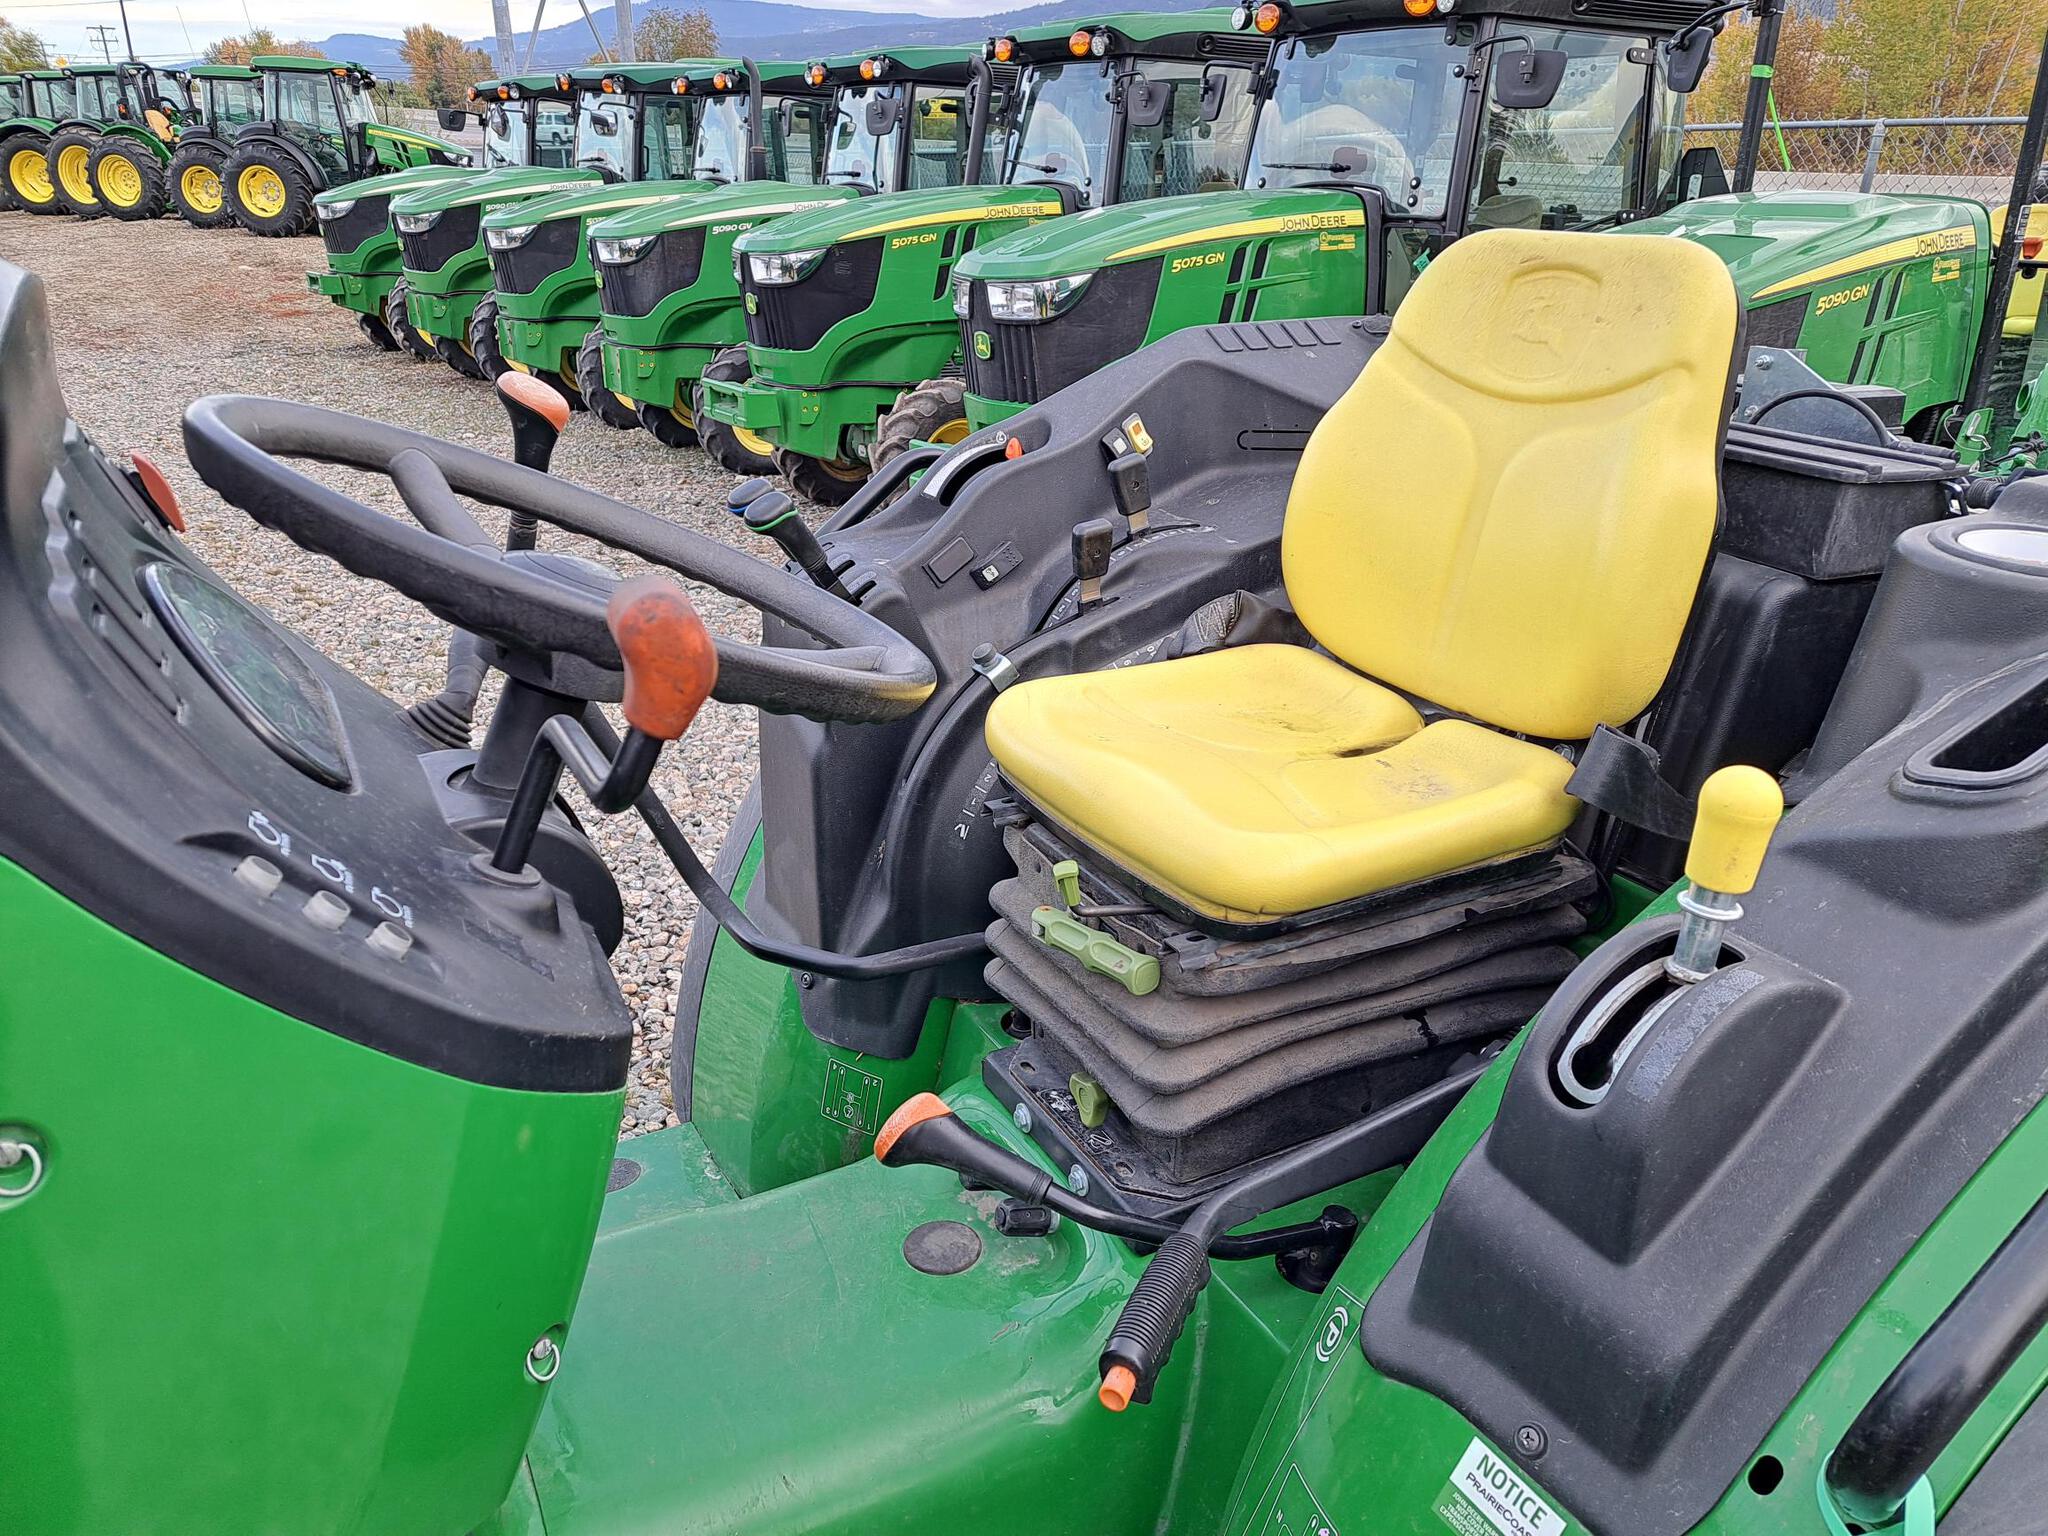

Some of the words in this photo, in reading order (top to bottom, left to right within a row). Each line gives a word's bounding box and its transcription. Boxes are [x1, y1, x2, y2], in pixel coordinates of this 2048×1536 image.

[984, 208, 1012, 219] JOHN
[1012, 204, 1046, 217] DEERE
[711, 223, 738, 235] 5090
[1280, 217, 1311, 232] JOHN
[1311, 214, 1347, 228] DEERE
[892, 236, 919, 249] 5075
[919, 232, 938, 244] GN
[1914, 236, 1939, 257] JOHN
[1938, 230, 1965, 250] DEERE
[1171, 257, 1205, 273] 5075
[1205, 251, 1226, 265] GN
[1815, 292, 1851, 318] 5090
[1851, 283, 1871, 301] GN
[1476, 1453, 1549, 1530] NOTICE
